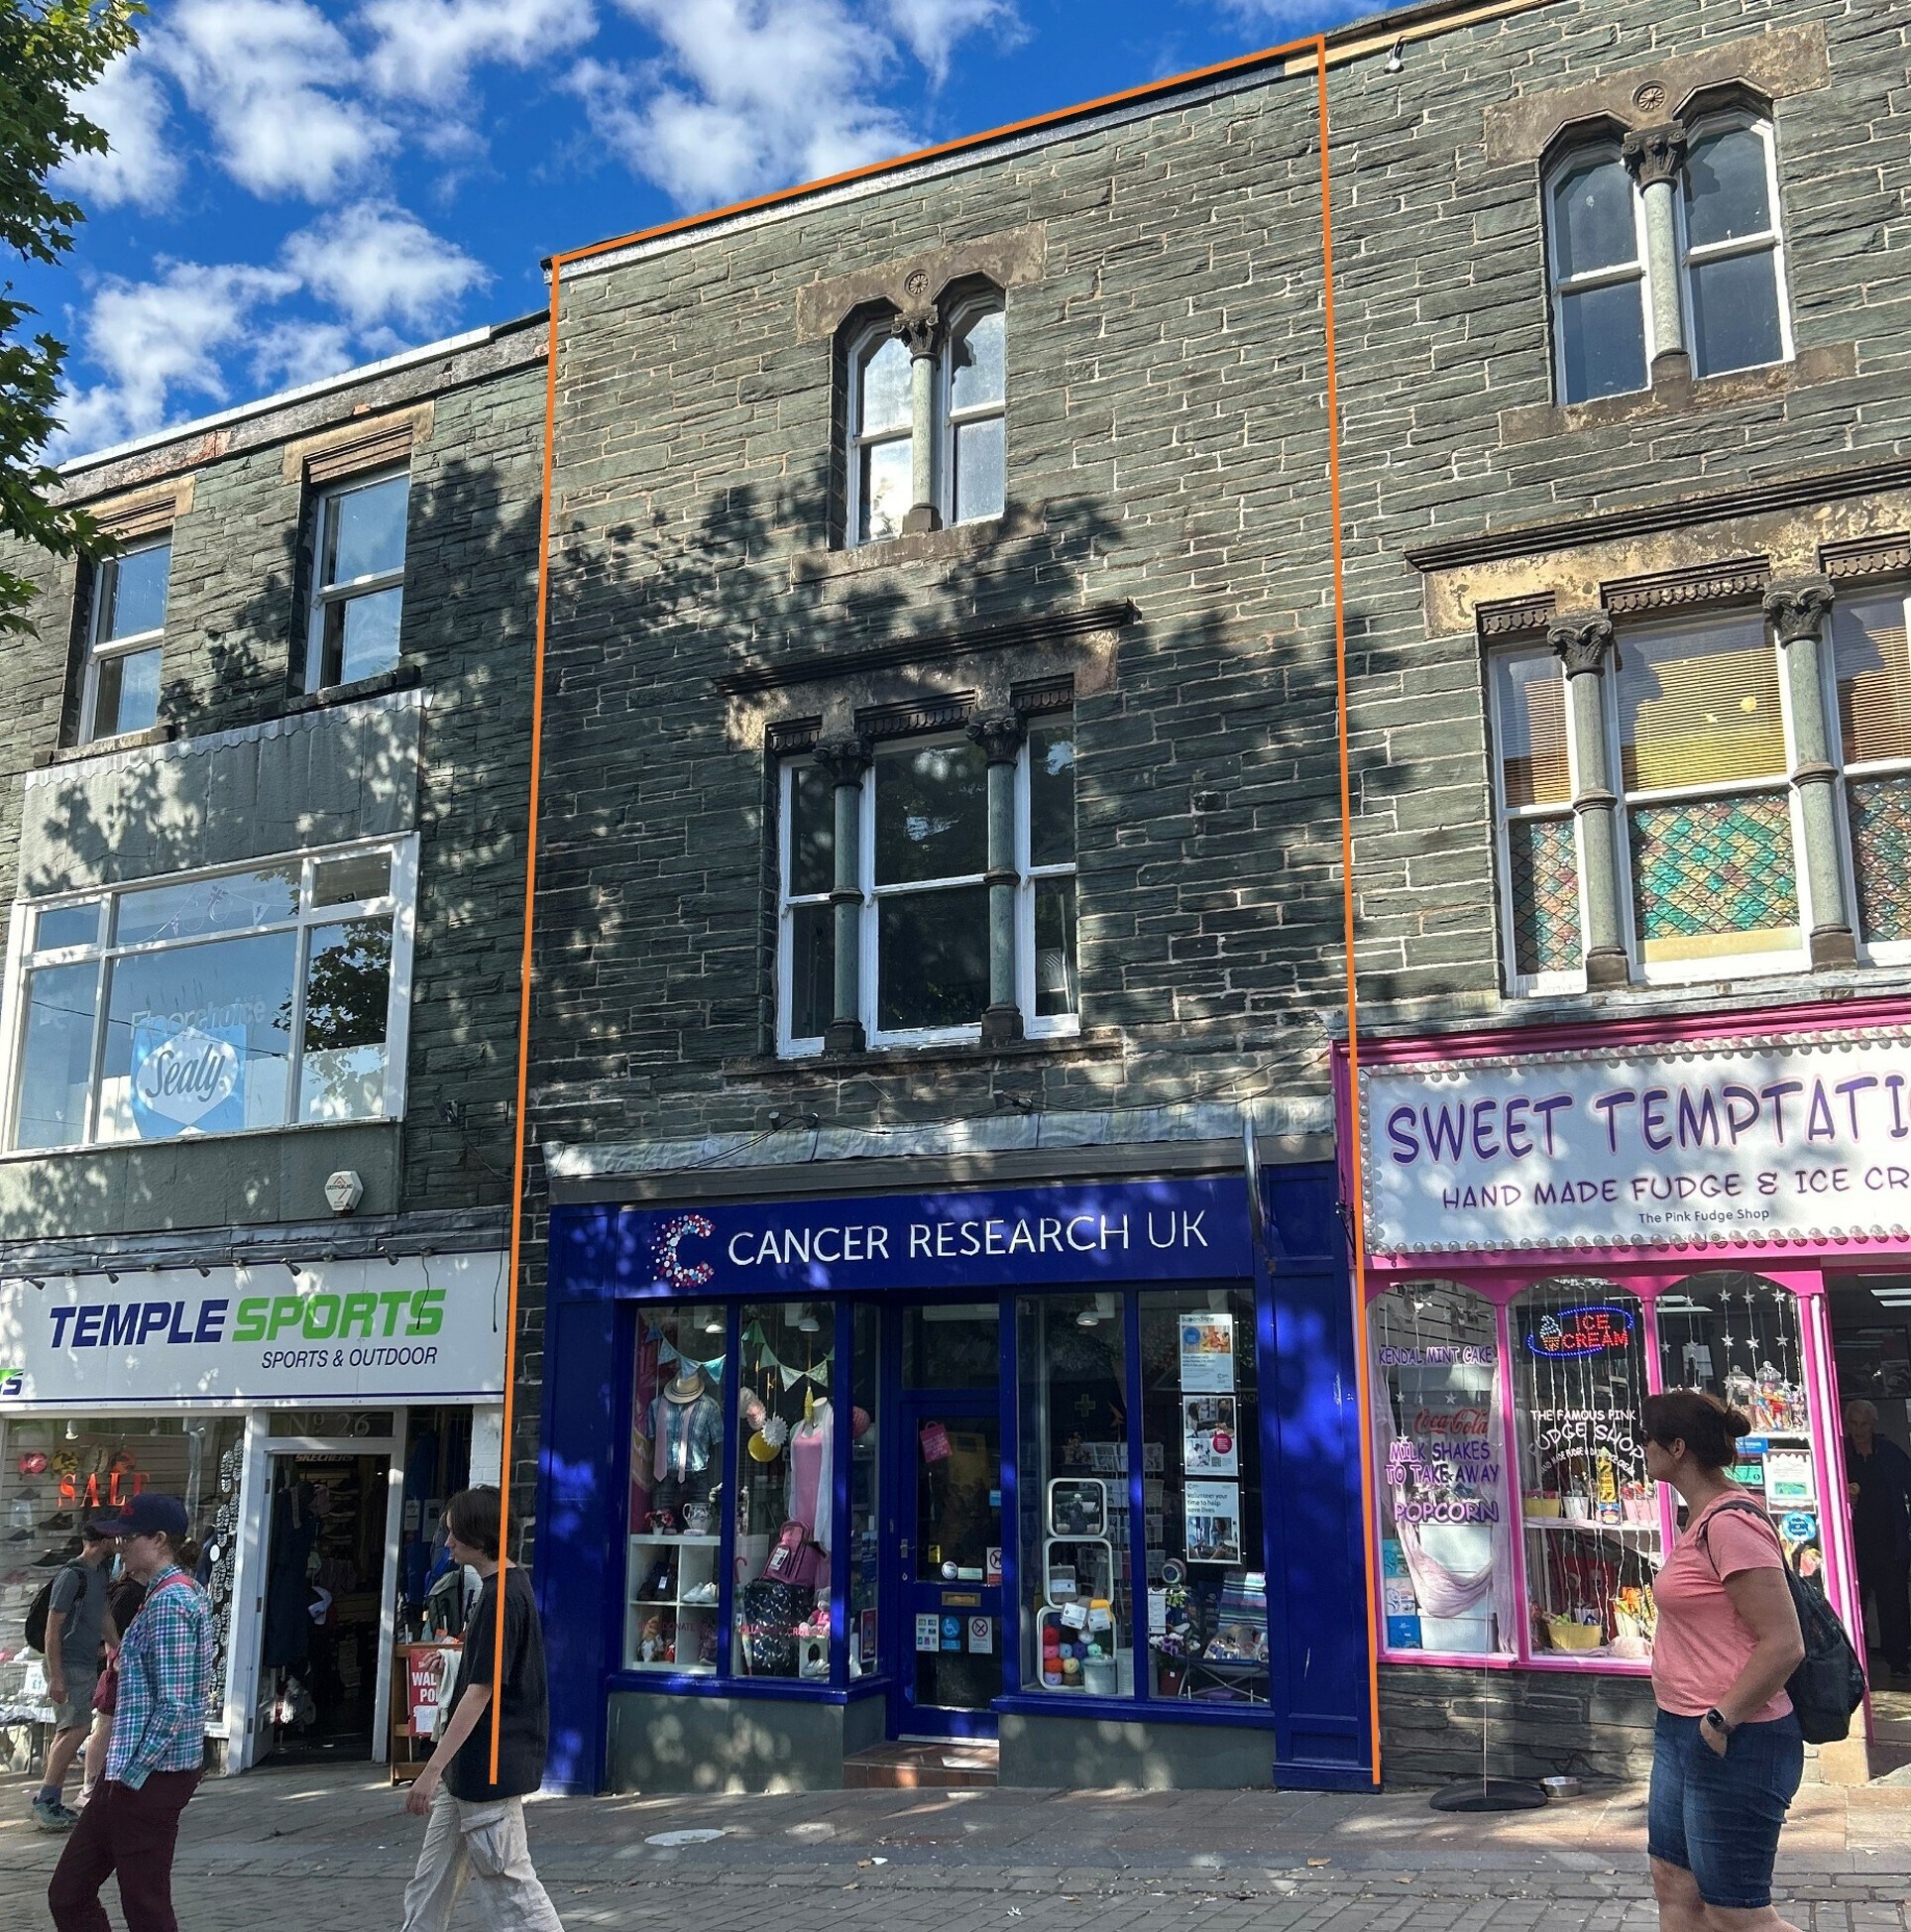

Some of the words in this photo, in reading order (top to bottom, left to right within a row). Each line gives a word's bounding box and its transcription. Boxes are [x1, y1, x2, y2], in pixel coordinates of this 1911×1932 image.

[145, 1044, 226, 1102] Sealy
[1388, 1095, 1573, 1165] SWEET
[1595, 1073, 1911, 1155] TEMPTATI
[1443, 1186, 1521, 1209] HAND
[1534, 1181, 1619, 1206] MADE
[1631, 1174, 1742, 1201] FUDGE
[1795, 1168, 1850, 1193] ICE
[1864, 1166, 1909, 1191] CR
[1638, 1211, 1662, 1223] The
[1665, 1210, 1691, 1223] Pink
[1694, 1209, 1734, 1224] Fudge
[1737, 1207, 1769, 1224] Shop
[728, 1224, 890, 1266] CANCER
[909, 1215, 1129, 1258] RESEARCH
[1147, 1209, 1208, 1249] UK
[50, 1299, 229, 1348] TEMPLE
[232, 1289, 447, 1342] SPORTS
[1575, 1313, 1611, 1329] ICE
[1561, 1330, 1629, 1348] CREAM
[262, 1349, 328, 1369] SPORTS
[332, 1349, 344, 1367] &
[348, 1346, 438, 1367] OUTDOOR
[1379, 1348, 1422, 1364] KENDAL
[1426, 1346, 1458, 1363] MINT
[1462, 1346, 1494, 1363] CAKE
[337, 1413, 371, 1436] 26
[1530, 1410, 1553, 1421] THE
[1556, 1410, 1605, 1421] FAMOUS
[1608, 1410, 1636, 1421] PINK
[1390, 1441, 1425, 1461] MILK
[1432, 1440, 1491, 1461] SHAKES
[1595, 1424, 1644, 1458] SHOP
[294, 1453, 355, 1462] SKECHERS
[1385, 1465, 1406, 1485] TO
[1410, 1464, 1449, 1485] TAKE
[1456, 1464, 1500, 1483] AWAY
[1395, 1501, 1499, 1523] POPCORN
[411, 1671, 436, 1687] WAL
